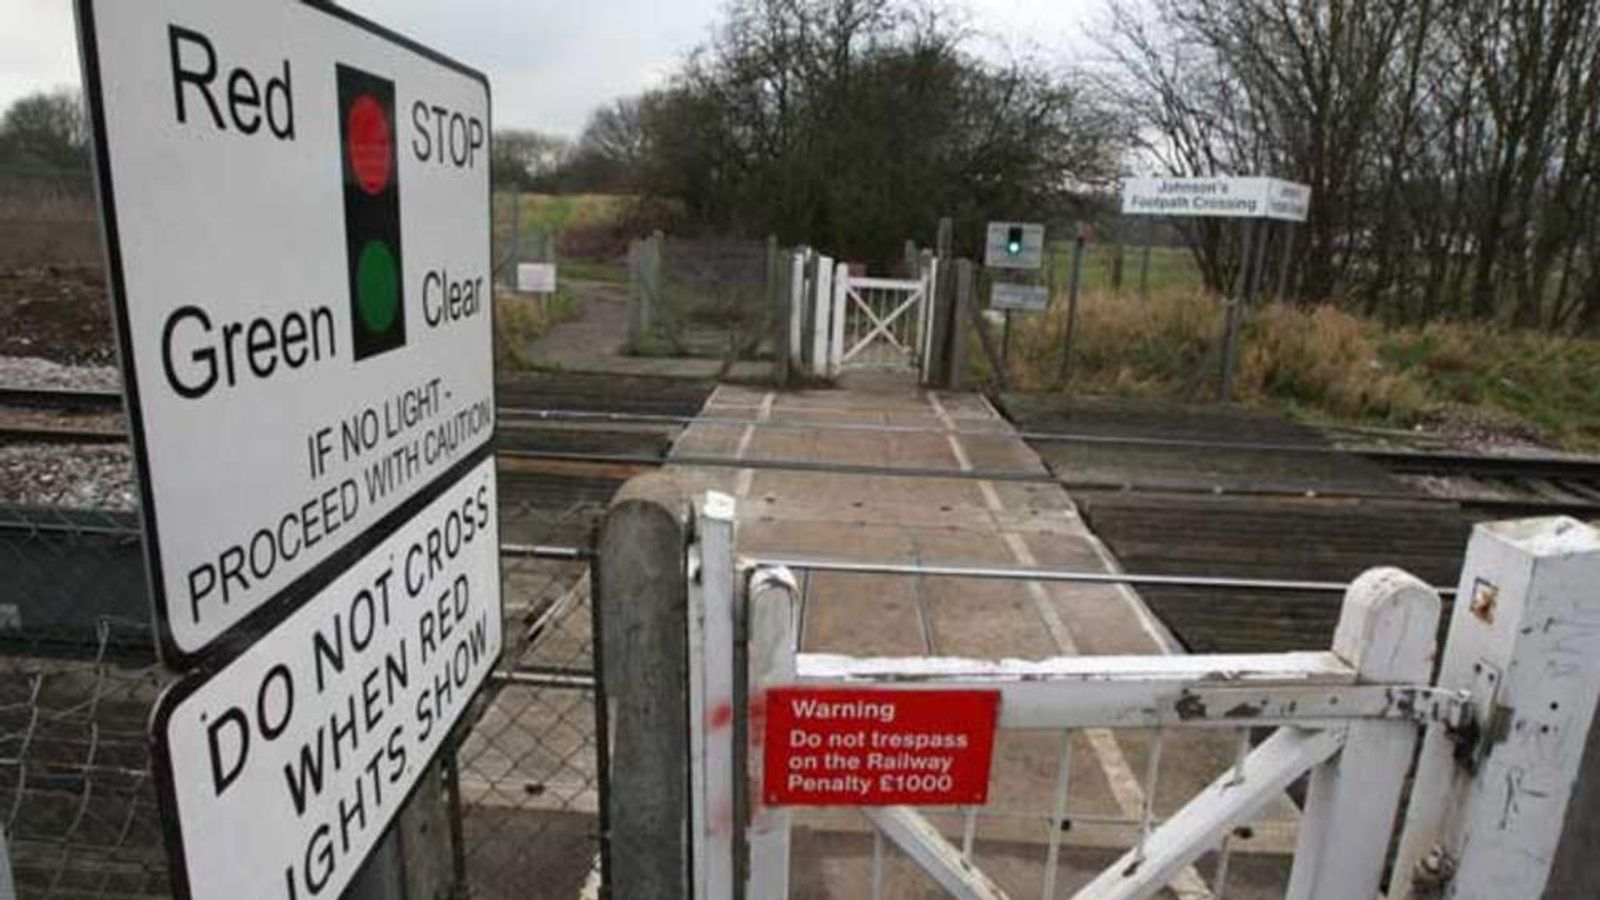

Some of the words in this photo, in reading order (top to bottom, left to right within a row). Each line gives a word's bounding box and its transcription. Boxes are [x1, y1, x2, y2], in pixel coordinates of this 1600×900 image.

[168, 24, 295, 141] Red
[411, 101, 484, 168] STOP
[1131, 195, 1189, 209] Footpath
[1193, 197, 1257, 212] Crossing
[1158, 181, 1229, 194] Johnson's
[422, 269, 483, 328] Clear
[162, 306, 336, 399] Green
[308, 427, 333, 480] IF
[341, 408, 380, 462] NO
[384, 378, 442, 439] LIGHT
[187, 479, 359, 624] PROCEED
[364, 444, 419, 504] WITH
[423, 396, 492, 467] CAUTION
[206, 664, 295, 797] DO
[312, 568, 394, 693] NOT
[403, 485, 490, 598] CROSS
[284, 639, 409, 817] WHEN
[418, 574, 470, 664] RED
[415, 610, 488, 742] SHOW
[789, 730, 823, 748] Do
[829, 731, 865, 748] not
[871, 731, 969, 751] trespass
[791, 700, 896, 722] Warning
[788, 756, 818, 770] on
[824, 752, 861, 770] the
[867, 753, 954, 773] Railway
[788, 775, 872, 795] Penalty
[879, 775, 953, 792] £1000
